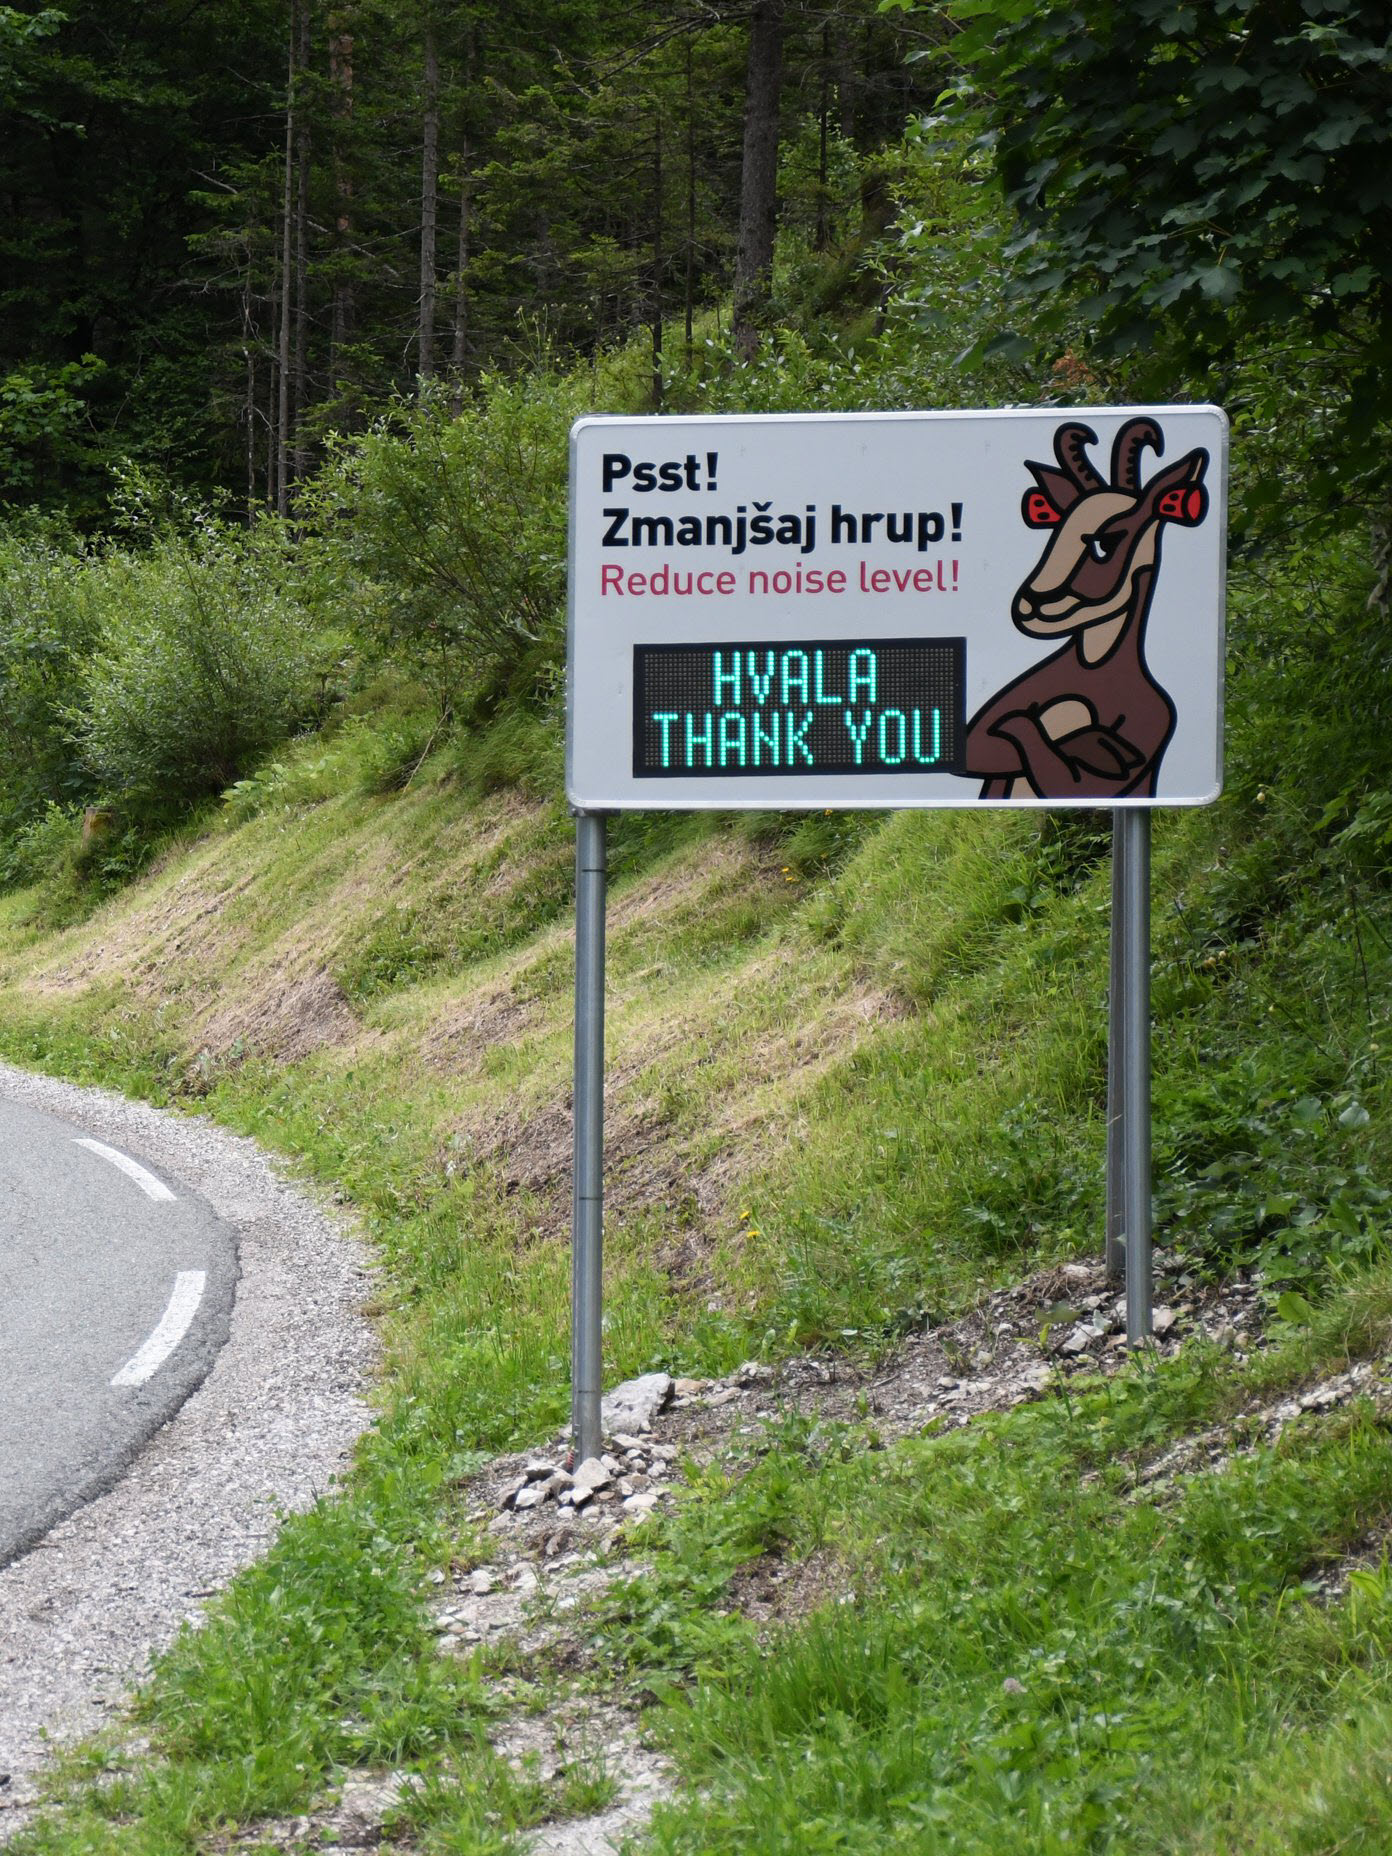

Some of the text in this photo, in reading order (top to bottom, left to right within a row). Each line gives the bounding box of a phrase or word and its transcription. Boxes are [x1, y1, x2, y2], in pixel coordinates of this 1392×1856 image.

[602, 452, 719, 493] Psst!
[602, 501, 964, 555] Zmanjšaj hrup!
[601, 559, 960, 596] Reduce noise level!
[714, 649, 877, 705] HVALA
[653, 708, 941, 767] THANK YOU
